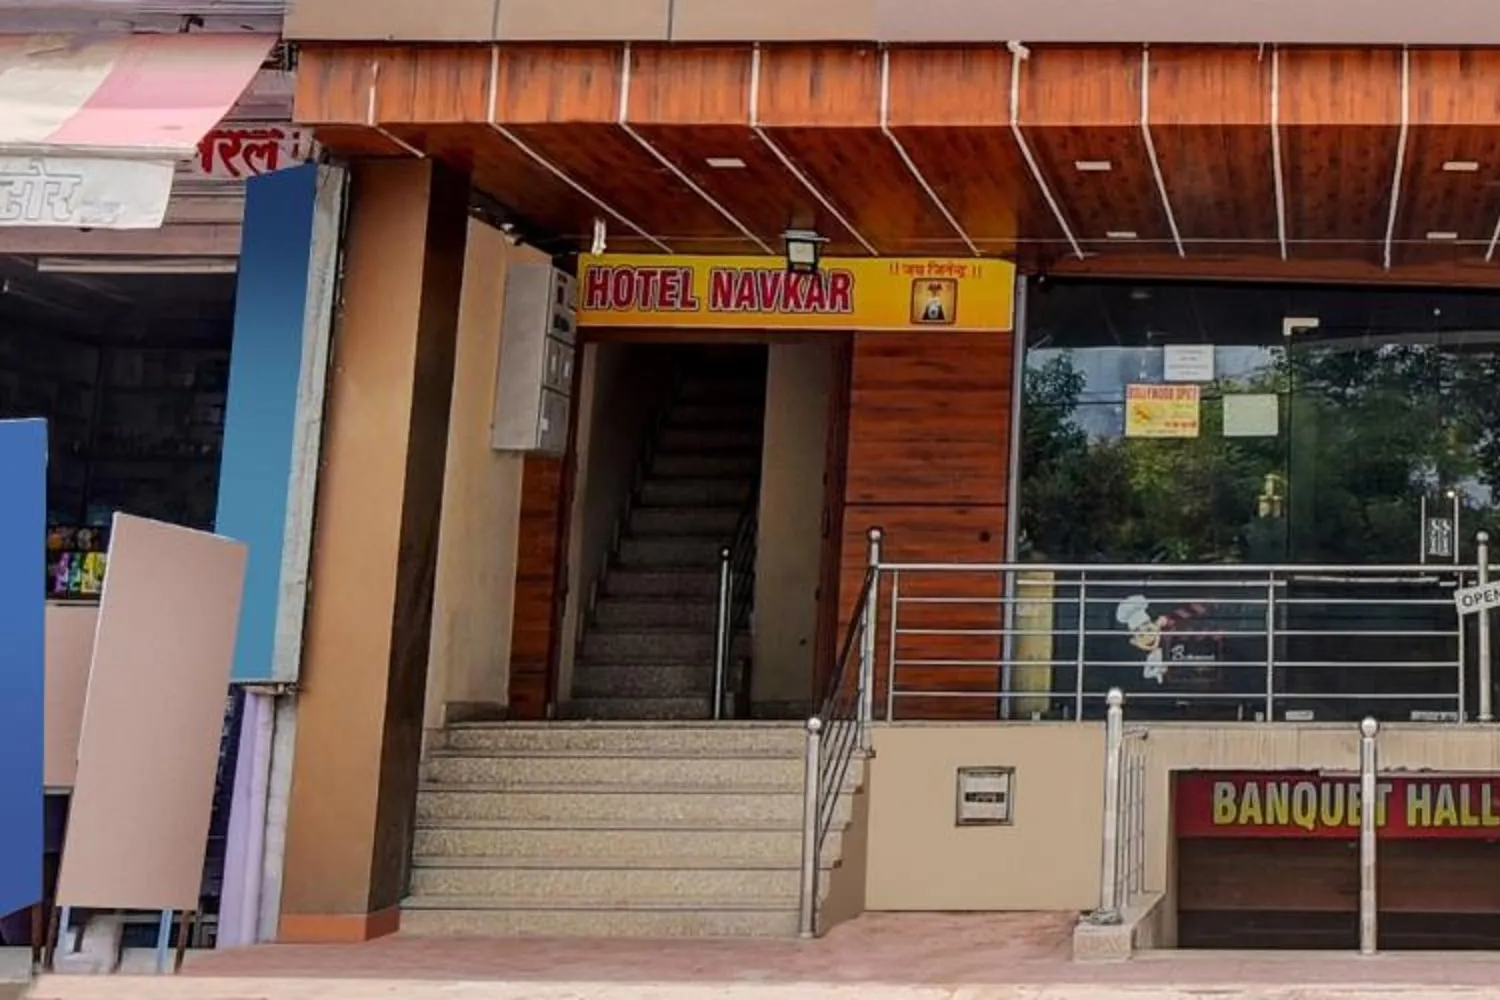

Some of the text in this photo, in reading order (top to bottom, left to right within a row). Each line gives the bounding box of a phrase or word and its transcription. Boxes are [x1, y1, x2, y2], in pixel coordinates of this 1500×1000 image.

[582, 265, 854, 314] HOTEL NAVKAR
[1212, 780, 1500, 830] BANQUET HALL
